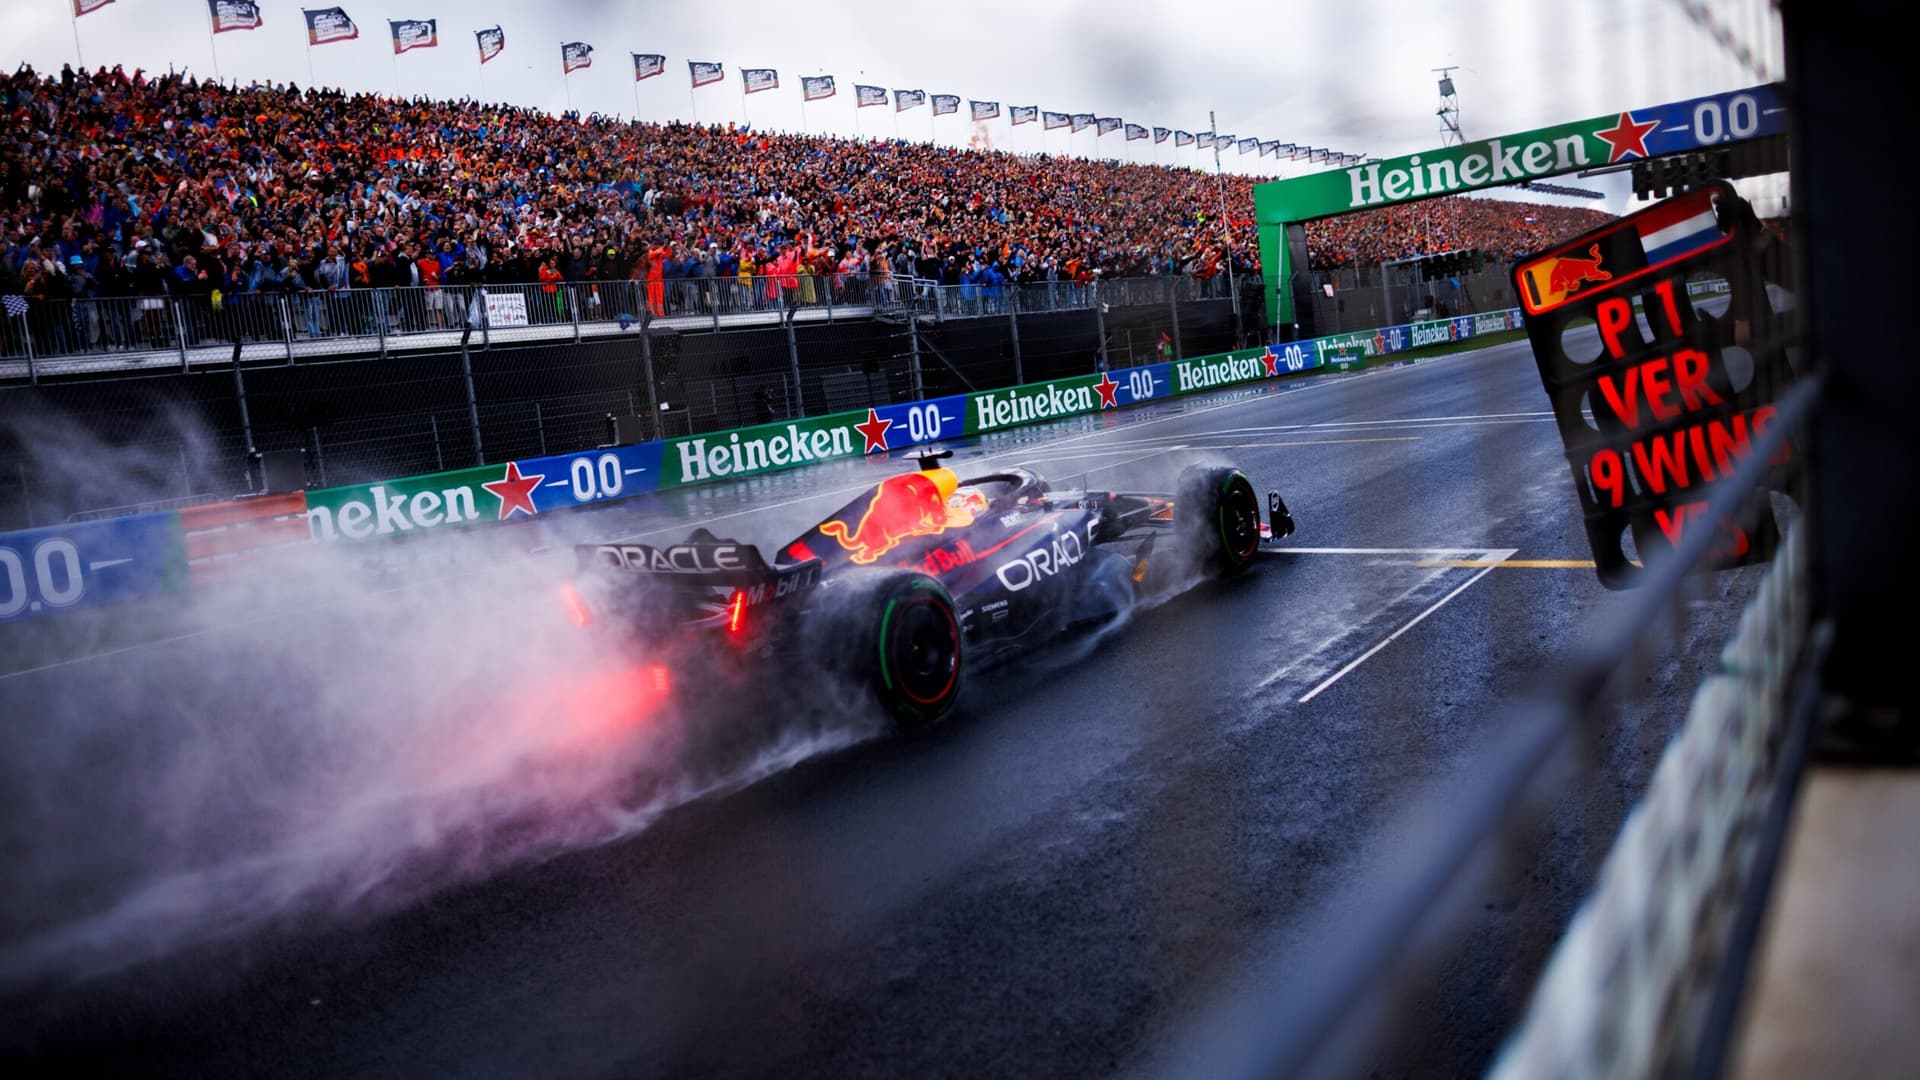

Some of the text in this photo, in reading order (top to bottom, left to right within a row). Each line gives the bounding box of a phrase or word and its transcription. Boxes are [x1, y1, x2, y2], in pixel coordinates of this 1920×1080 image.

[1348, 94, 1759, 208] Heineken 0.0
[1411, 322, 1450, 347] Heineken
[1475, 313, 1506, 335] Heineken
[1178, 344, 1304, 391] Heineken 0.0
[1598, 348, 1726, 430] VER
[974, 368, 1155, 431] Heineken 0.0
[675, 402, 942, 483] Heineken 0.0
[296, 452, 623, 542] neken 0.0
[1590, 448, 1623, 510] 9
[595, 545, 746, 572] ORACLE
[933, 539, 976, 572] Bull
[996, 517, 1100, 592] ORACLE
[746, 572, 800, 607] Mobil
